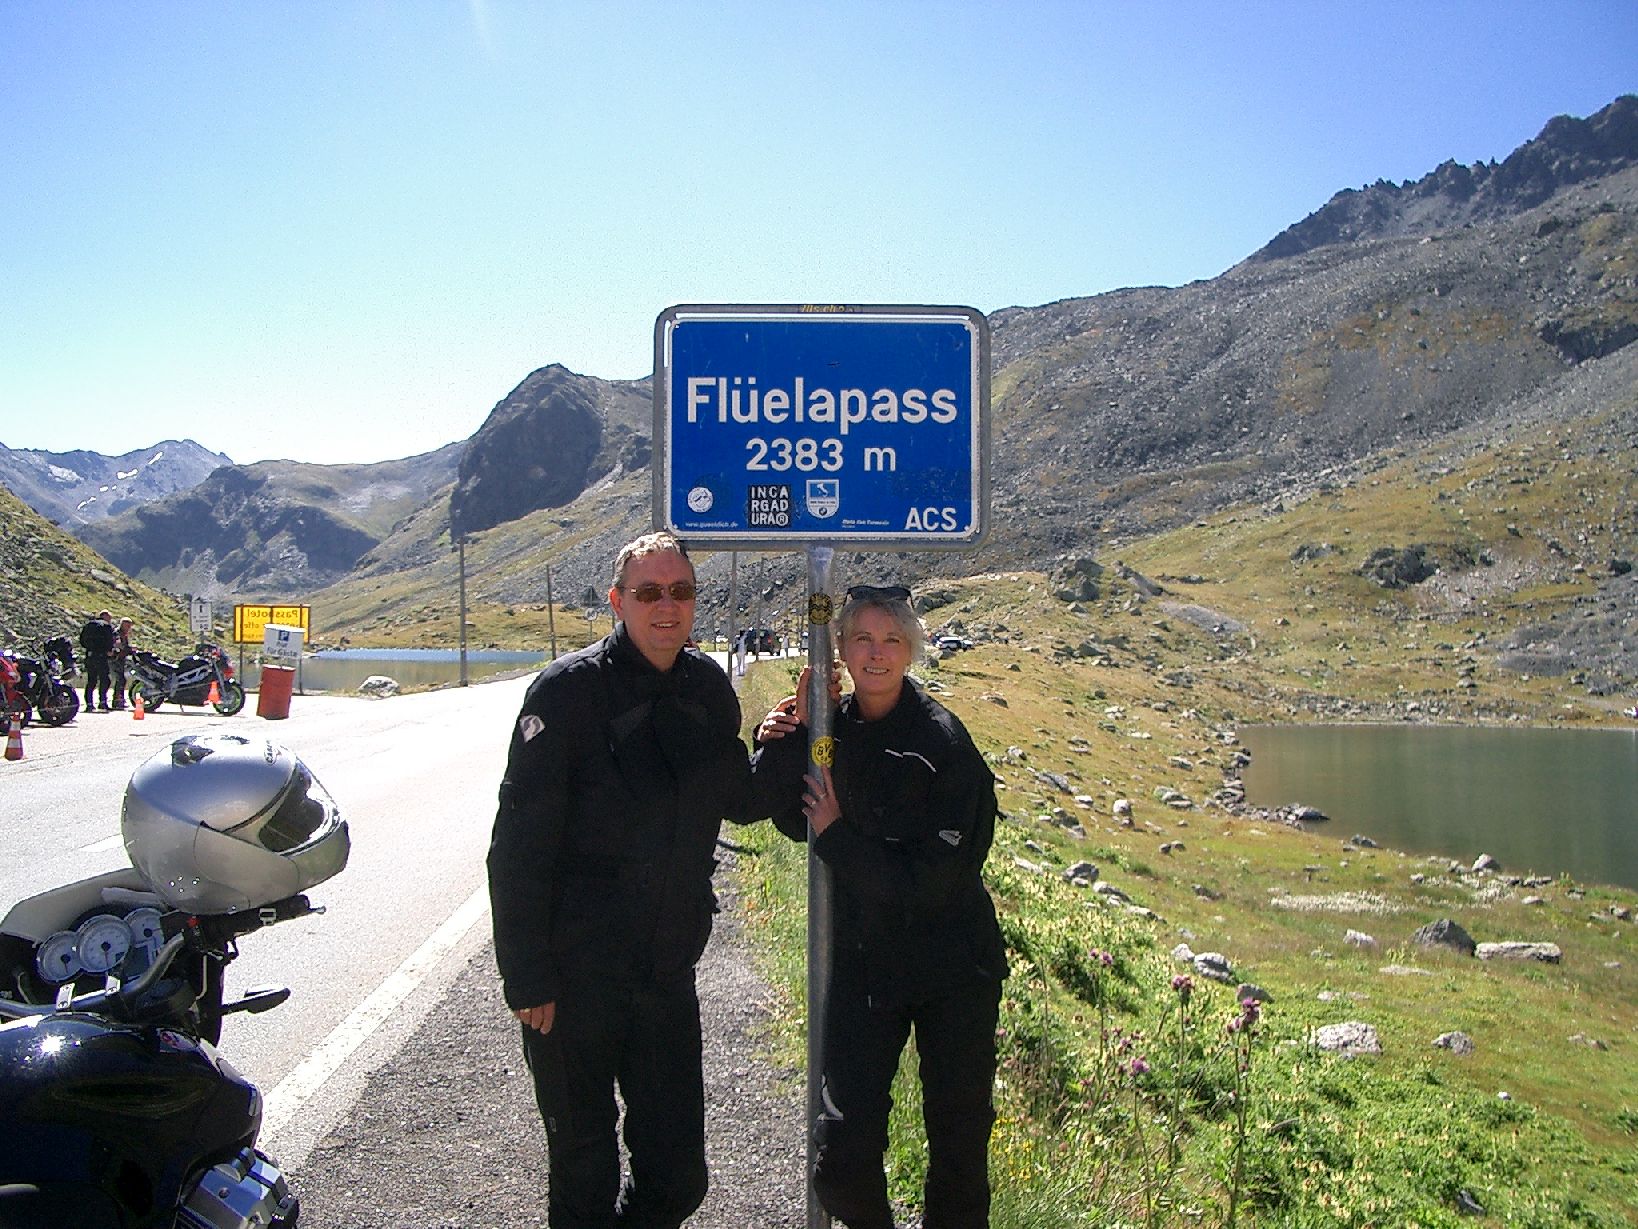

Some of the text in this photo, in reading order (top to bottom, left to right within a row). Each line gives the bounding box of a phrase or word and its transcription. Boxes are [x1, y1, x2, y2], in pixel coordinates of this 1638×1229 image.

[687, 376, 957, 435] Flüelapass
[745, 438, 896, 472] 2383 m
[750, 485, 789, 499] INCA
[750, 499, 789, 513] RGAD
[904, 507, 957, 531] ACS
